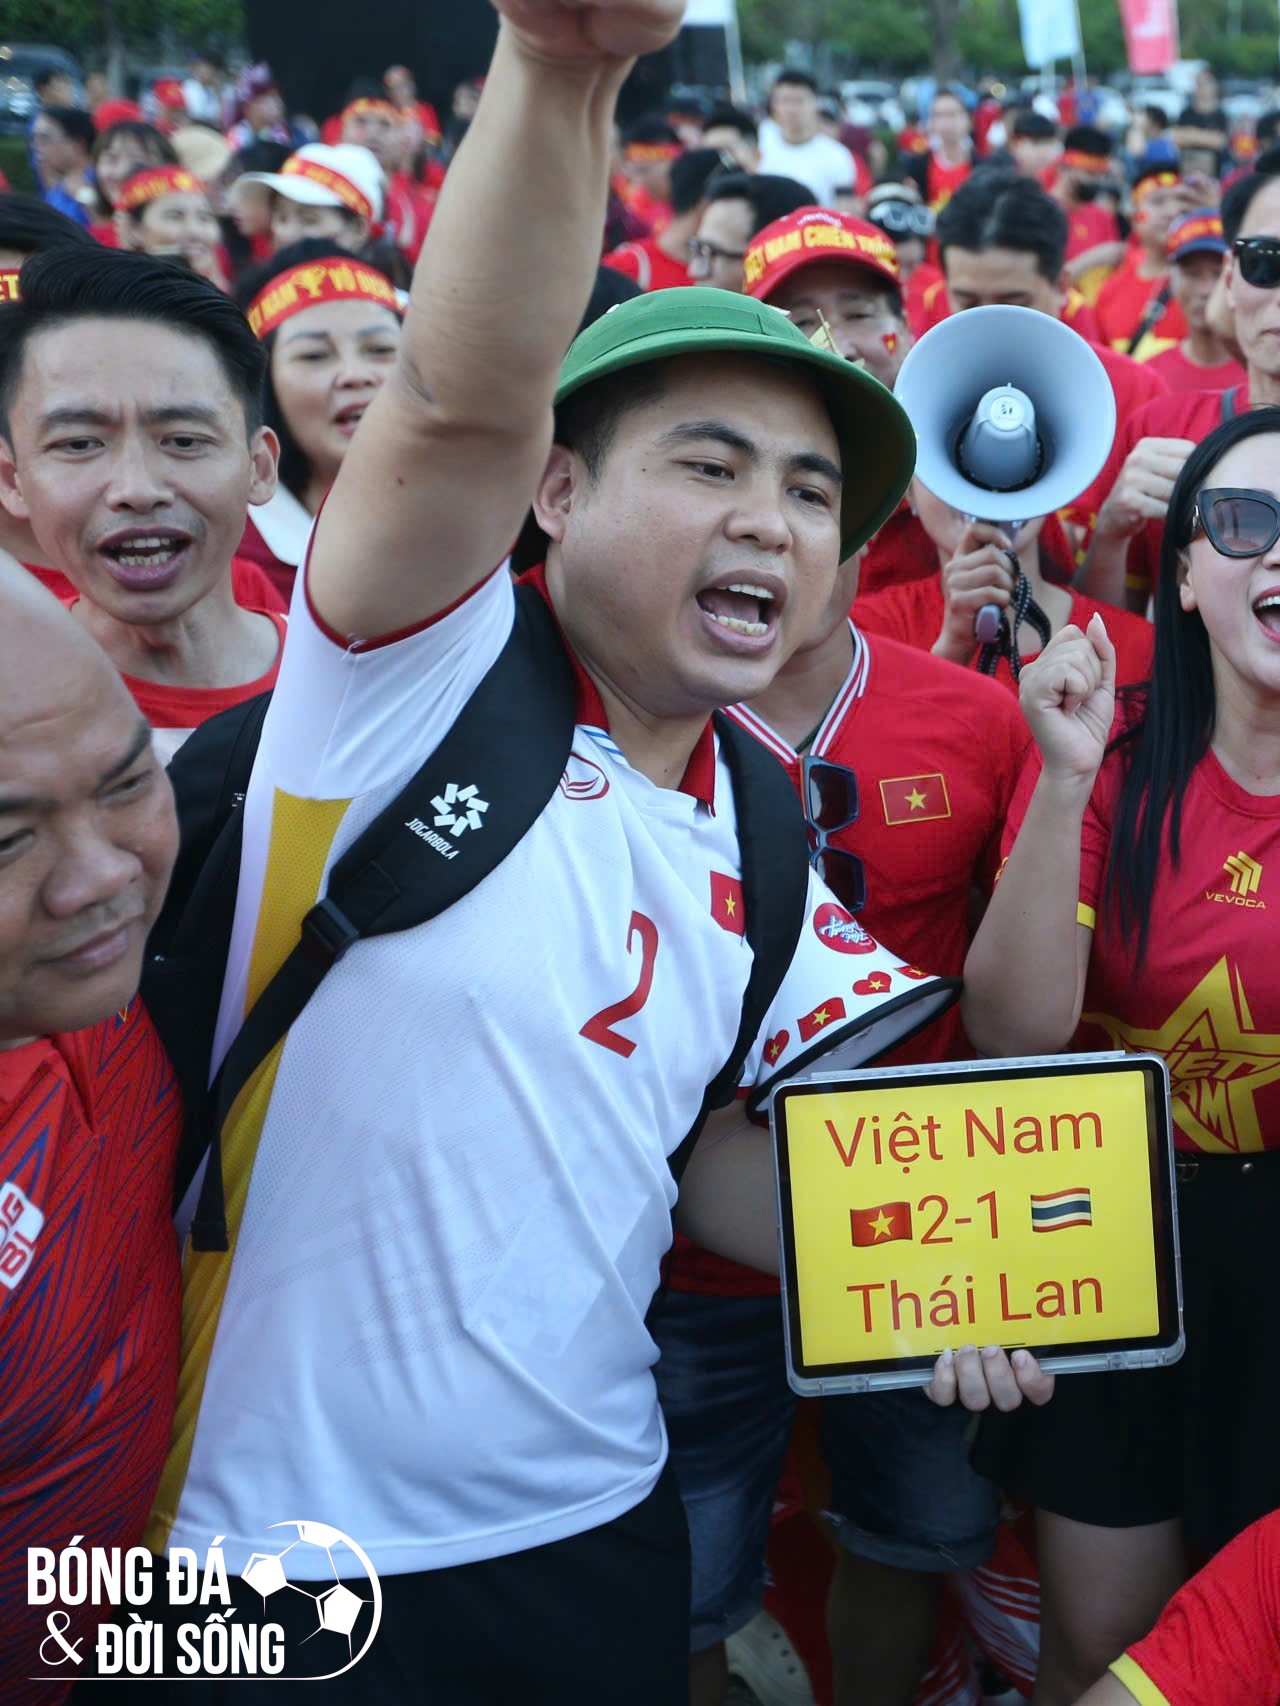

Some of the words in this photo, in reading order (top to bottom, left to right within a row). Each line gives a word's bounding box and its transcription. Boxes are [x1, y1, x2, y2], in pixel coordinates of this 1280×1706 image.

[1205, 890, 1266, 910] VEVOCA
[578, 909, 659, 1060] 2
[824, 1111, 943, 1175] Việt
[965, 1106, 1103, 1158] Nam
[917, 1190, 999, 1246] 2-1
[846, 1274, 976, 1333] Thái
[999, 1272, 1104, 1322] Lan
